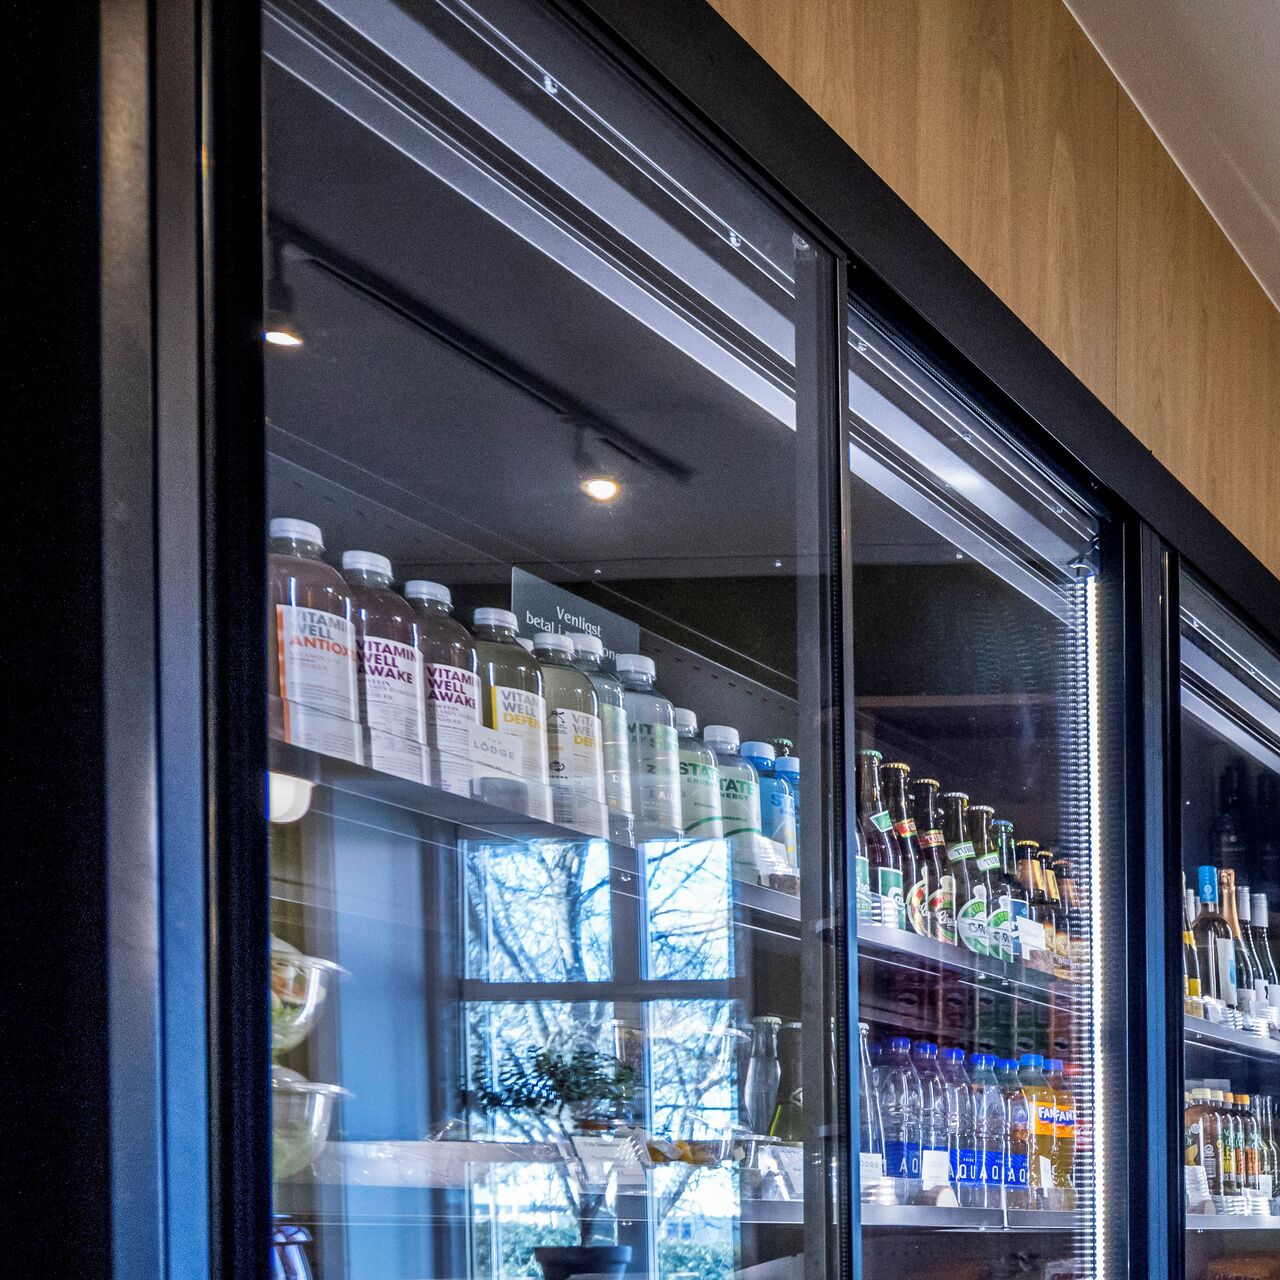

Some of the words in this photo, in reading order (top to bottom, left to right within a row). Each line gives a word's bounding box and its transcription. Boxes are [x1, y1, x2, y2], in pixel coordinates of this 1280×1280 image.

[526, 610, 554, 633] betal
[556, 605, 602, 637] Venligst
[356, 651, 400, 669] WELL
[357, 664, 414, 684] AWAKE
[427, 678, 467, 695] WELL
[503, 701, 536, 718] WELL
